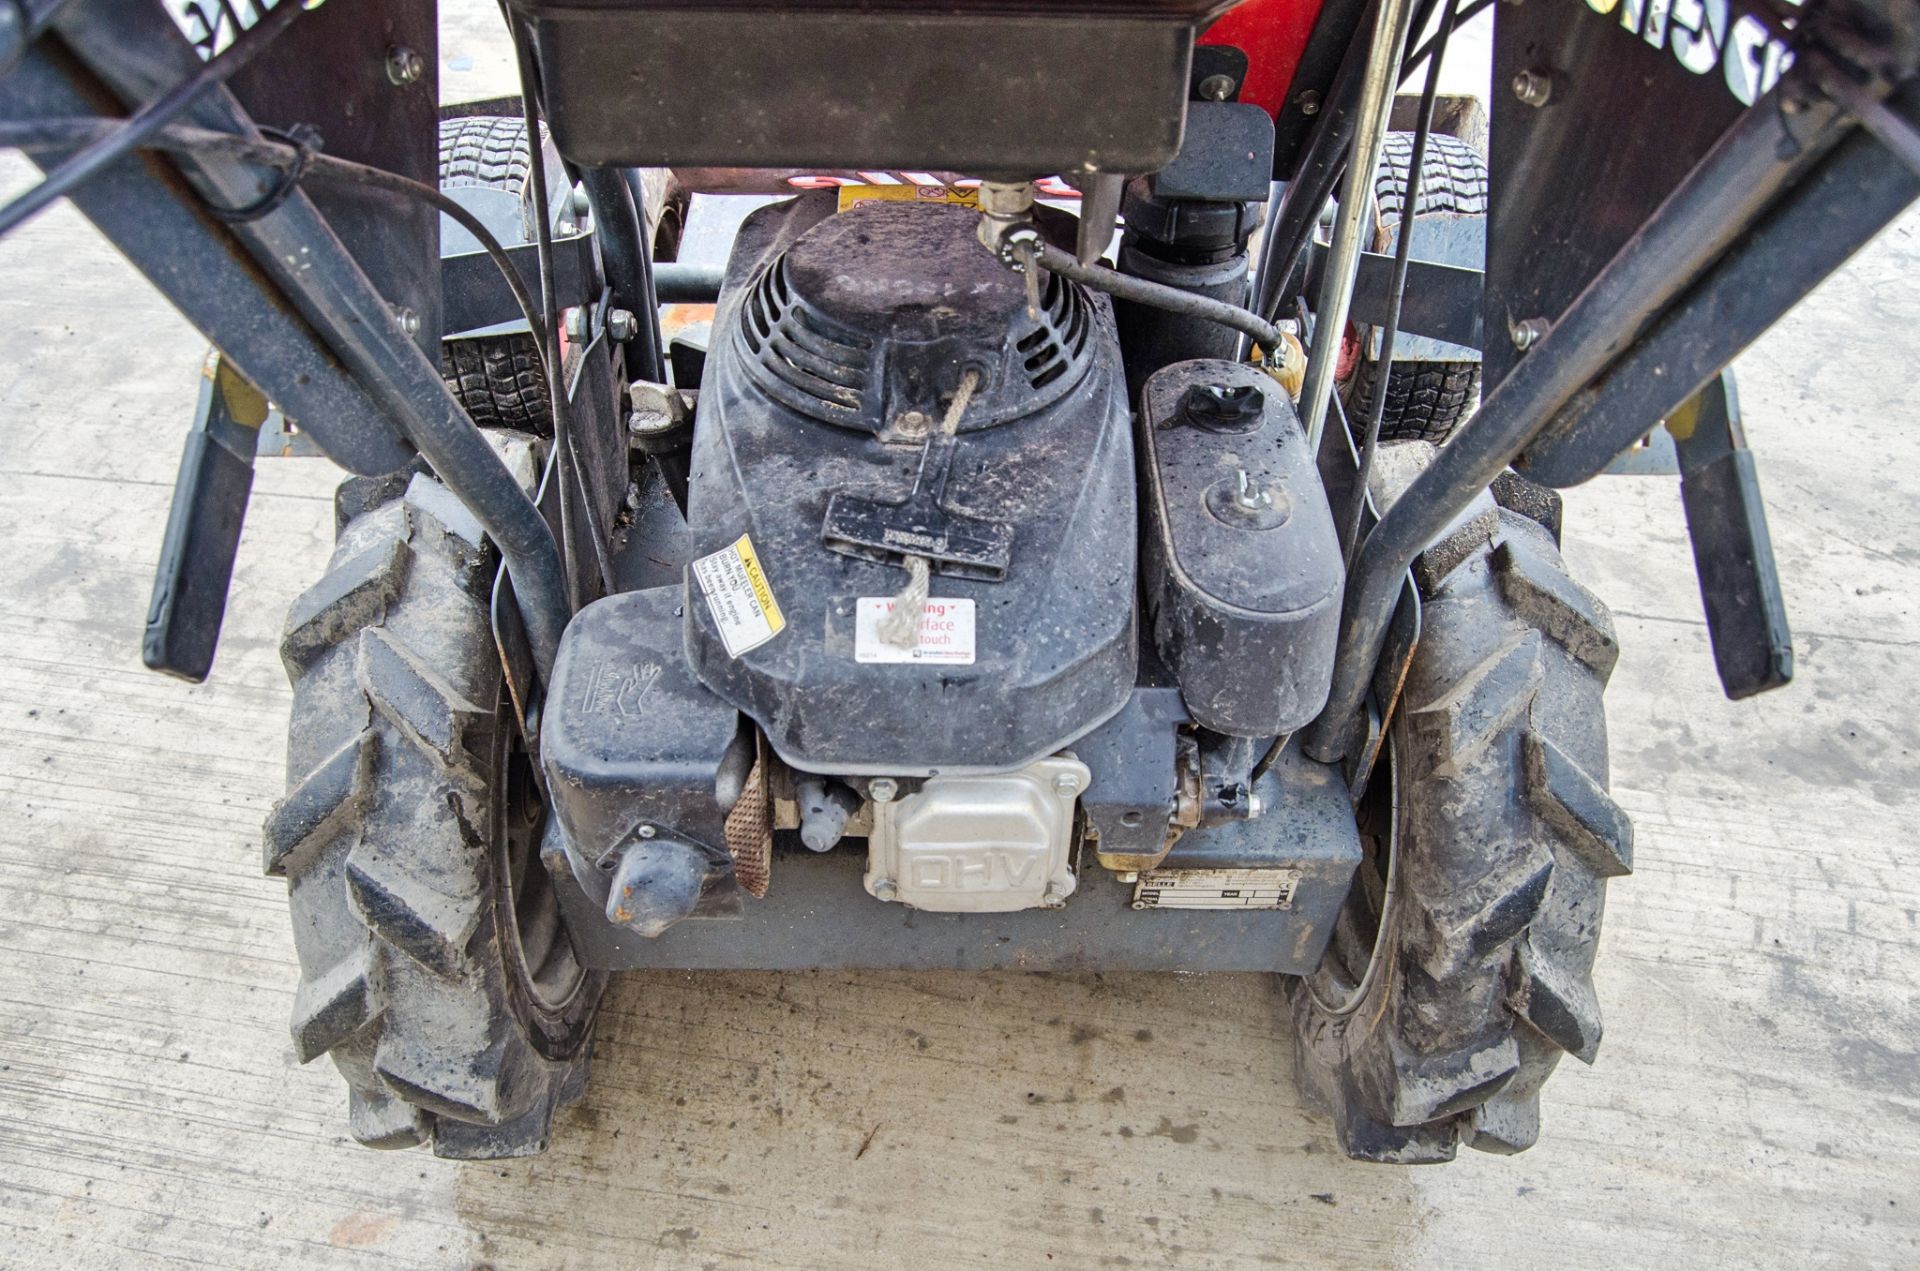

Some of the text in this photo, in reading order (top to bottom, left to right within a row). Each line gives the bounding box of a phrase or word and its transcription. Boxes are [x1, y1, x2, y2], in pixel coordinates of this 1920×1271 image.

[719, 553, 734, 576] BURN
[709, 557, 719, 574] Stay
[716, 574, 727, 593] away
[726, 600, 742, 626] engine
[728, 548, 762, 618] HOT MUFFLER CAN
[749, 567, 772, 610] CAUTION
[886, 603, 945, 616] Wing
[919, 619, 955, 632] rface
[920, 635, 951, 645] touch
[911, 853, 1038, 888] OHV
